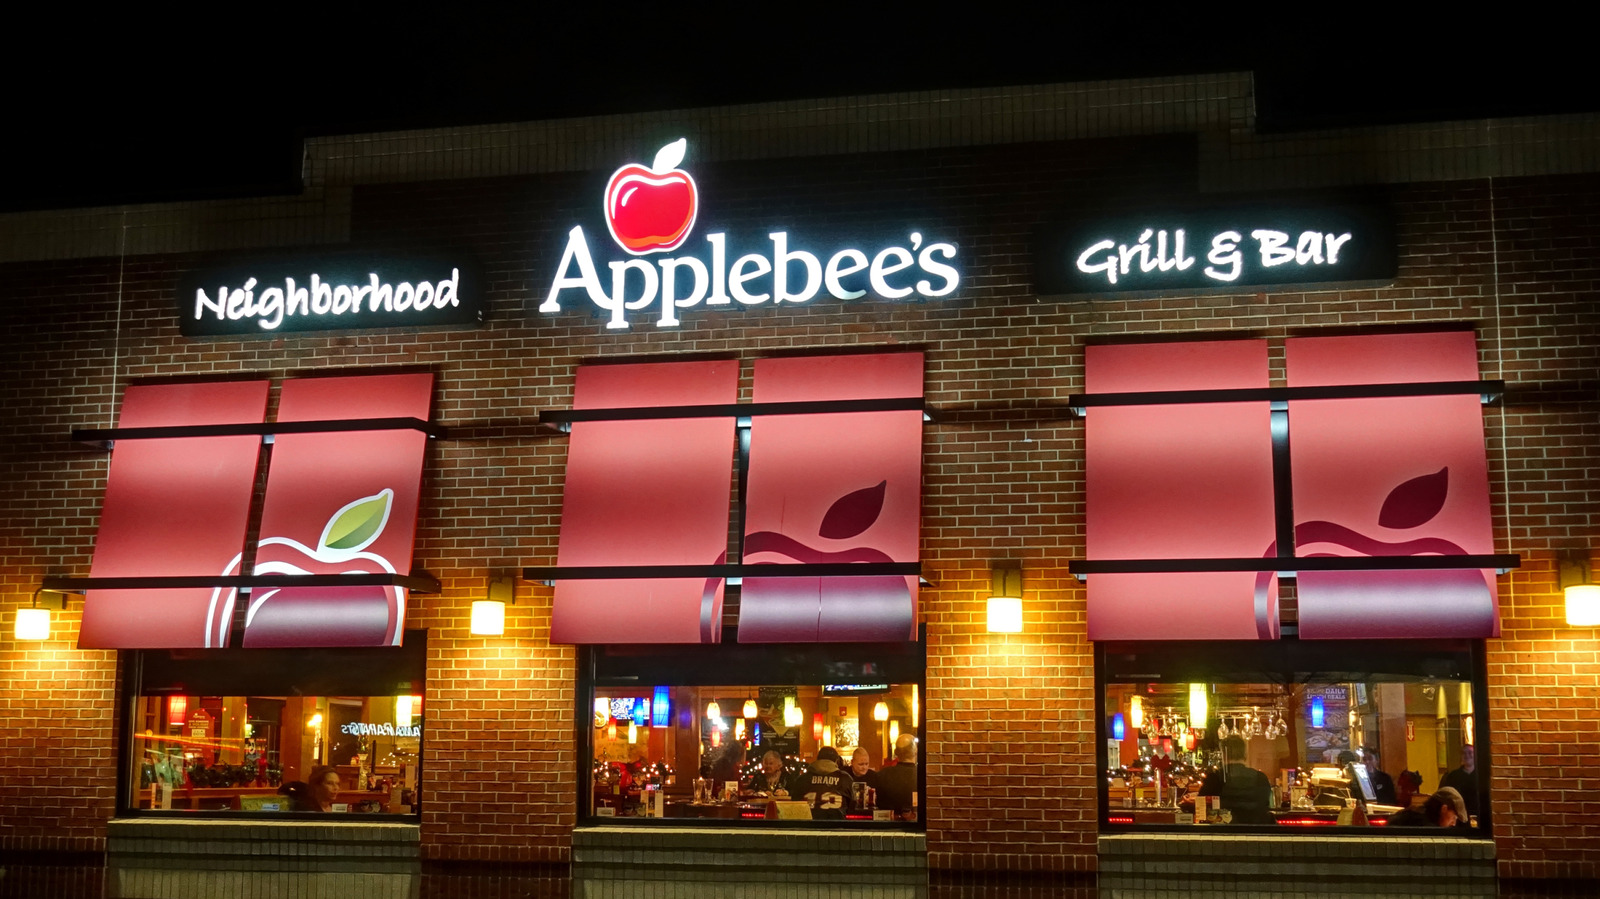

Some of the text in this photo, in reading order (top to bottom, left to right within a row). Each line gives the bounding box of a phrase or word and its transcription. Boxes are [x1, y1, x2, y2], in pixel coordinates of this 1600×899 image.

[538, 224, 960, 329] Applebee's
[1076, 228, 1352, 284] Grill & Bar
[194, 267, 460, 330] Neighborhood
[811, 776, 839, 785] BRADY
